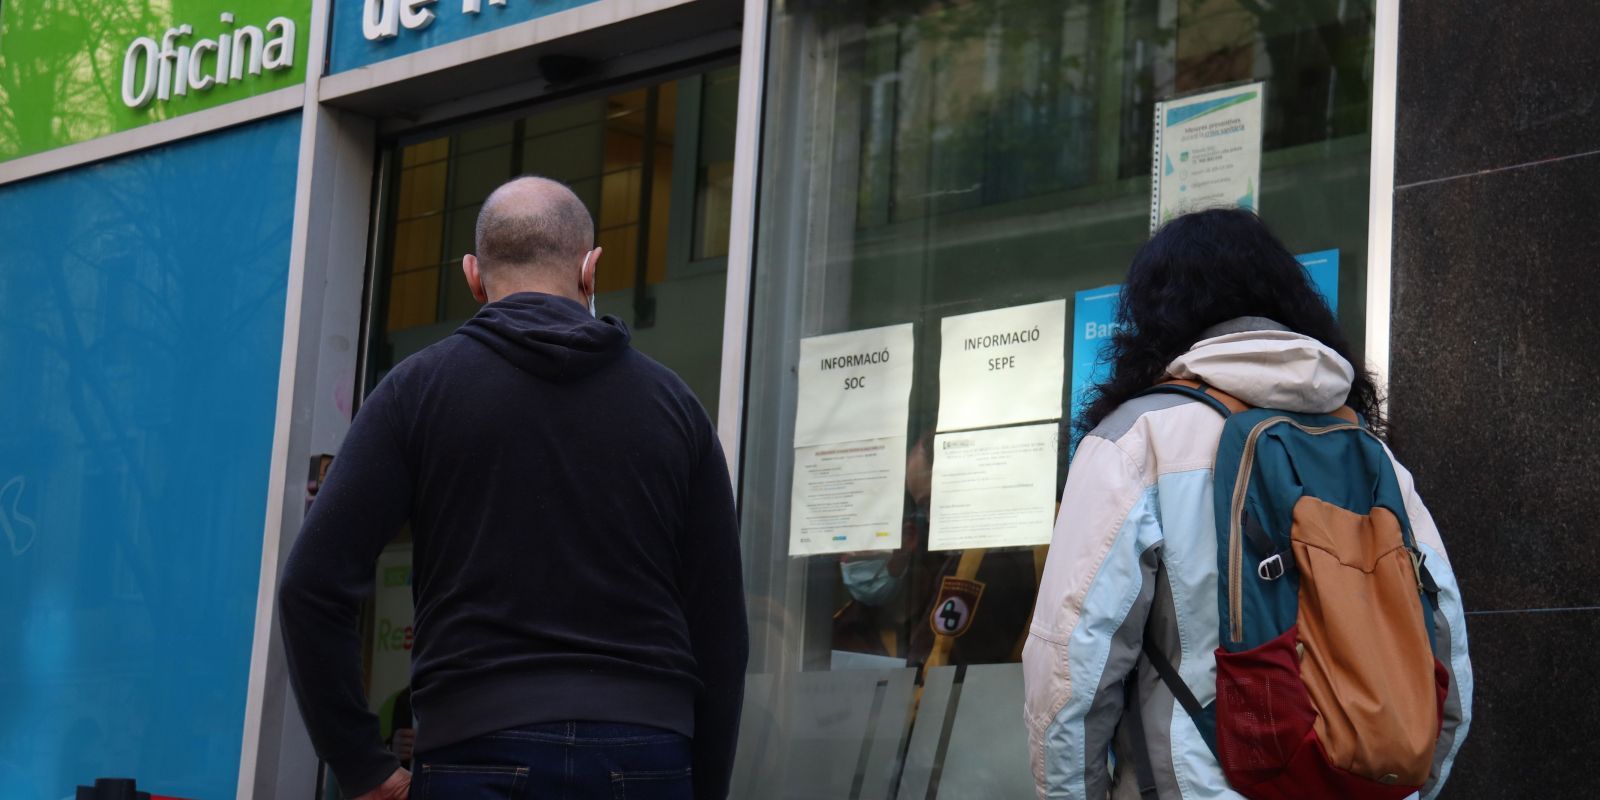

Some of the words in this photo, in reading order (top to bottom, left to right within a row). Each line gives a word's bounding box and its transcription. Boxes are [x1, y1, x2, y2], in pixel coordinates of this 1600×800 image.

[121, 12, 296, 108] Oficina
[963, 324, 1040, 351] INFORMACIÓ
[820, 347, 890, 371] INFORMACIÓ
[988, 355, 1016, 372] SEPE
[844, 376, 866, 390] SOC
